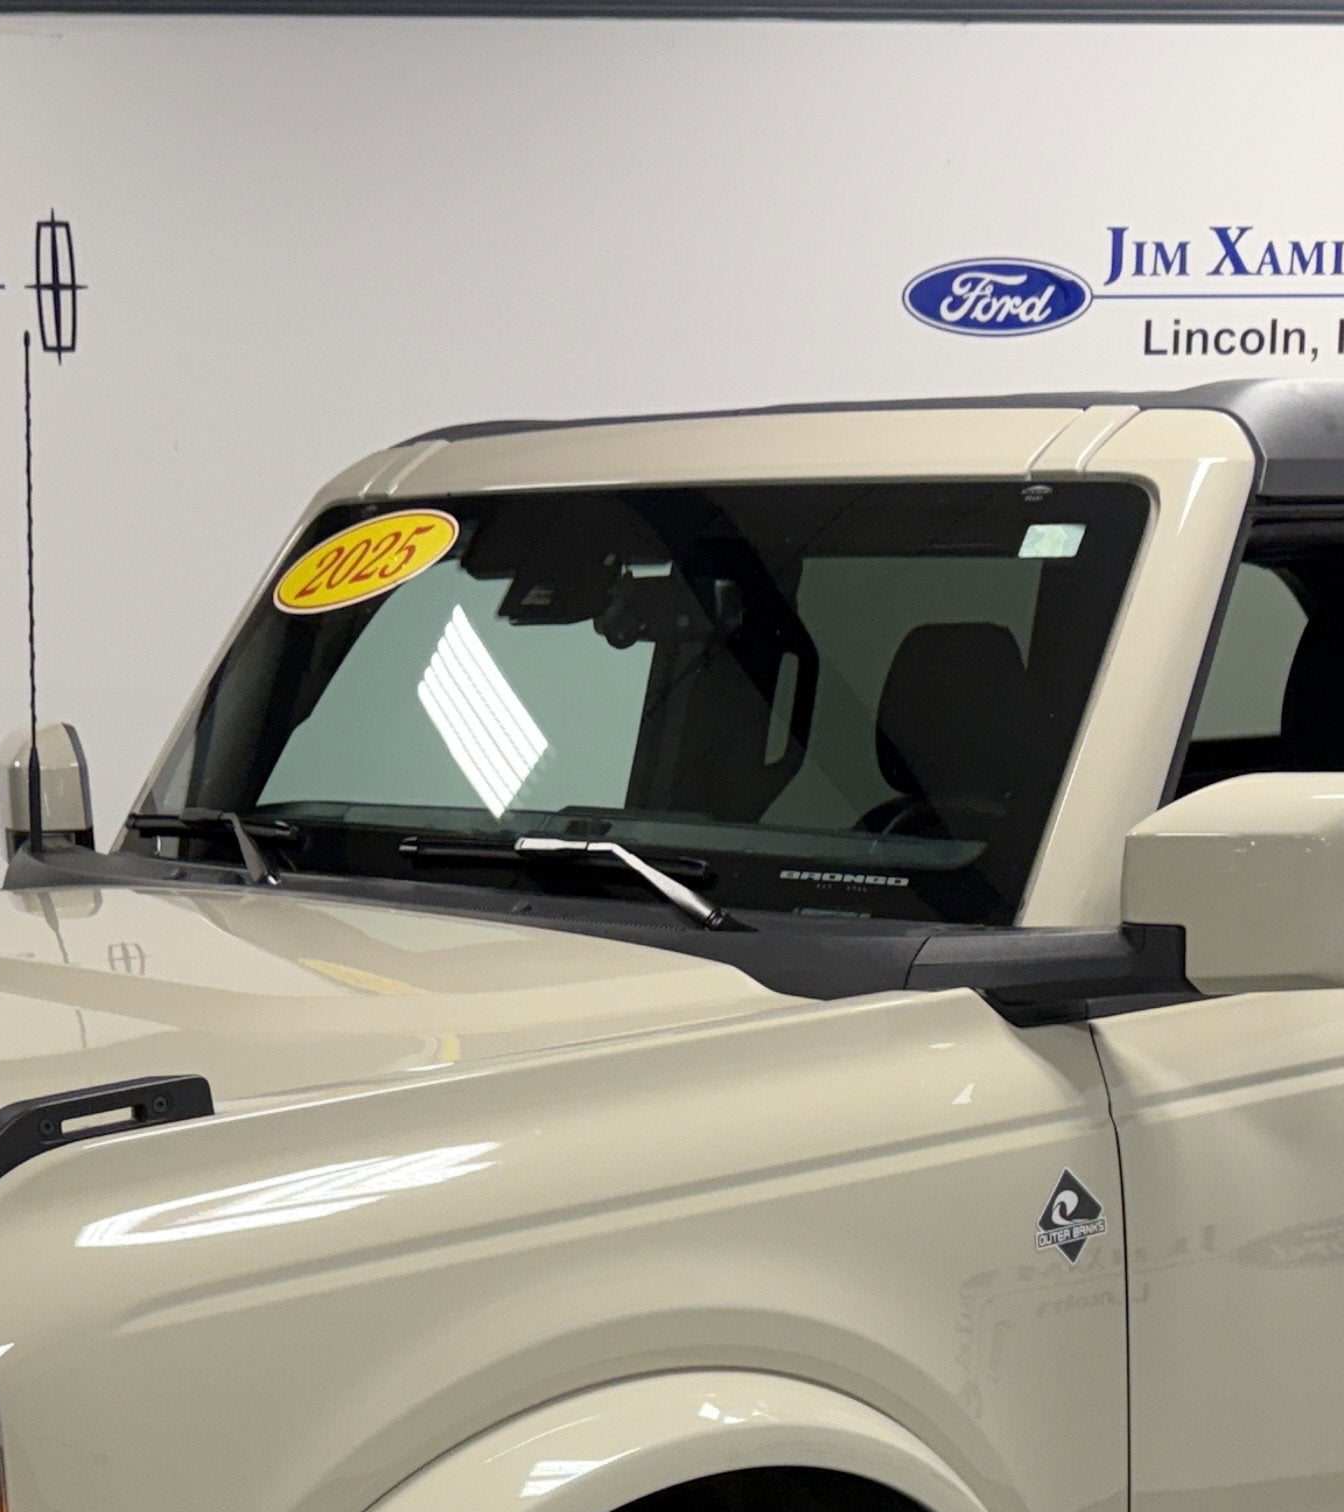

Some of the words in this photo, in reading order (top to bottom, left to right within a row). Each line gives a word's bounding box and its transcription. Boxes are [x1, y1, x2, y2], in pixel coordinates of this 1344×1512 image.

[938, 273, 1056, 324] Ford
[1143, 318, 1318, 362] Lincoln,
[294, 524, 436, 600] 2025
[779, 870, 910, 887] BRONCO
[1038, 1228, 1072, 1247] OUTER
[1072, 1220, 1106, 1239] BANKS
